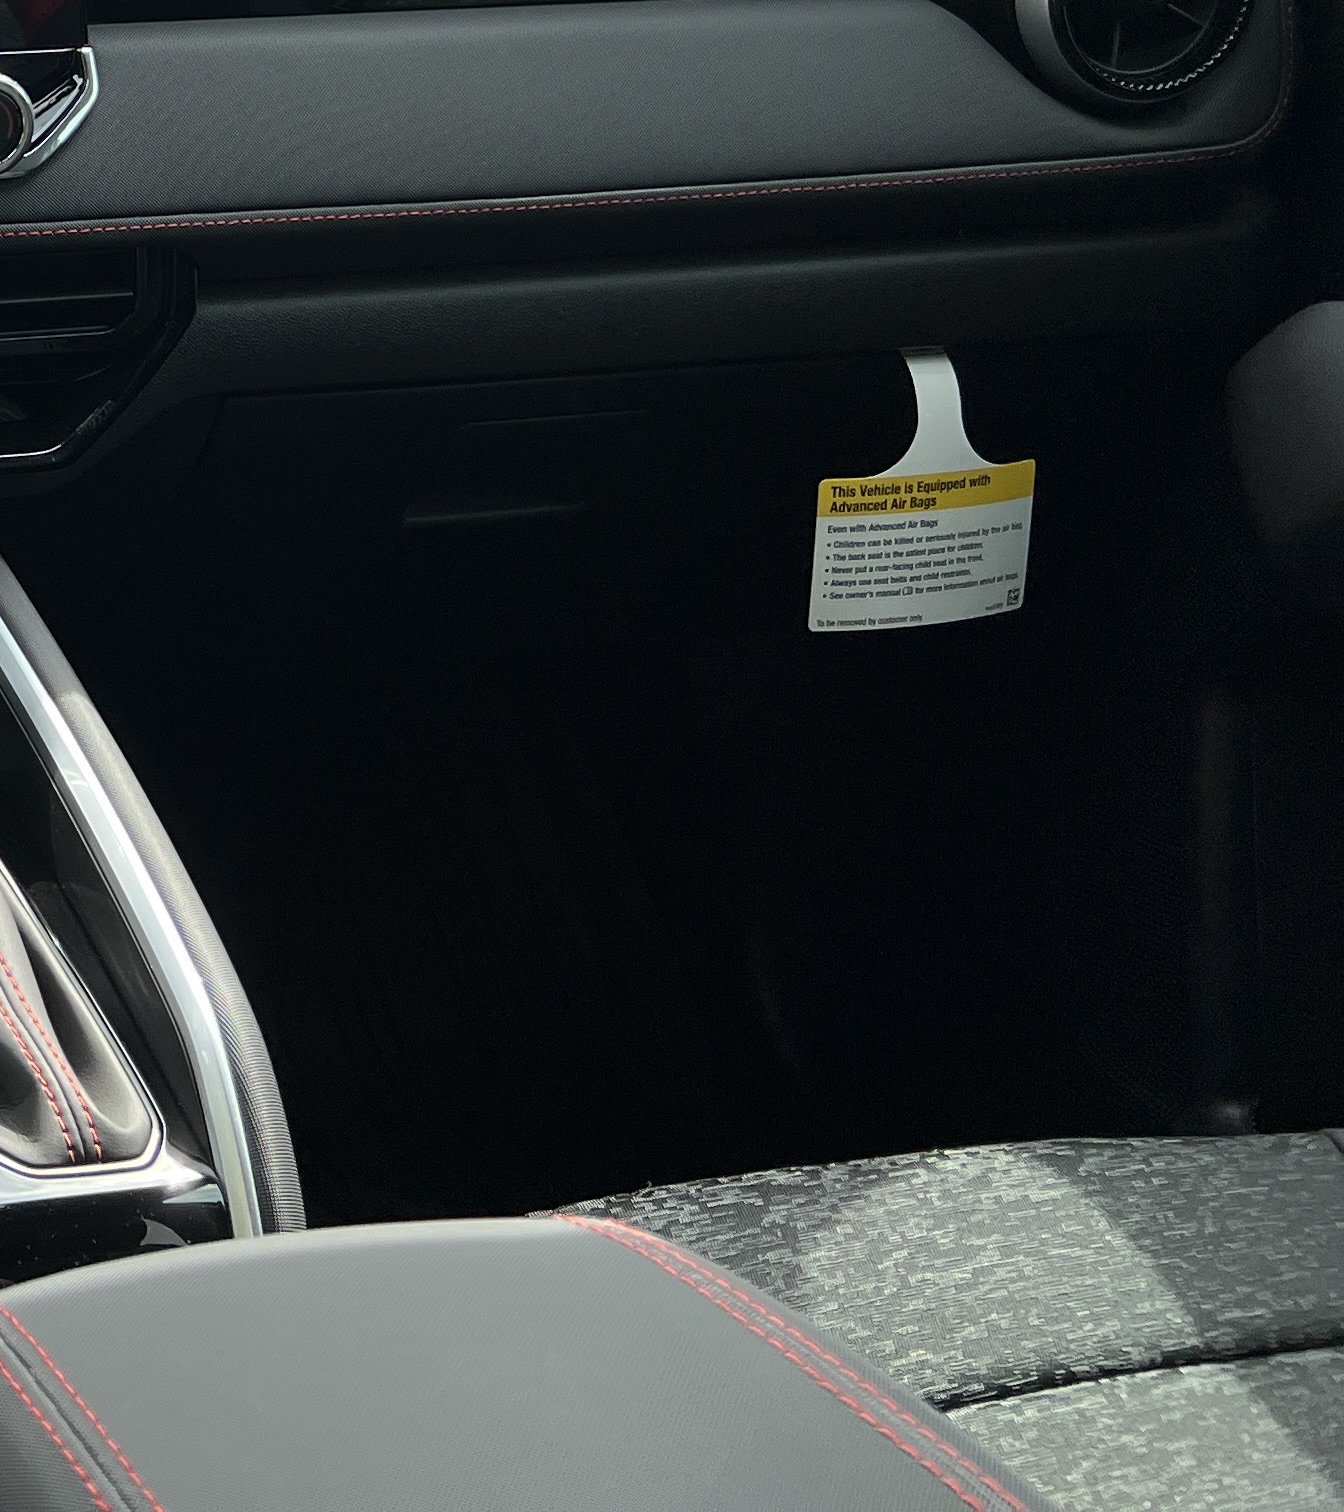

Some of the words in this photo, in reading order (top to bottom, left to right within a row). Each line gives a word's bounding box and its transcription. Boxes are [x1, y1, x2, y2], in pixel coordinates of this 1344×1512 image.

[831, 485, 856, 499] This
[859, 481, 901, 497] Vehicle
[917, 477, 966, 494] Equipped
[968, 474, 991, 488] with
[829, 498, 887, 513] Advanced
[890, 498, 908, 510] Air
[910, 497, 937, 509] Bags
[828, 525, 847, 534] Even
[868, 521, 906, 532] Advanced
[907, 520, 919, 529] Air
